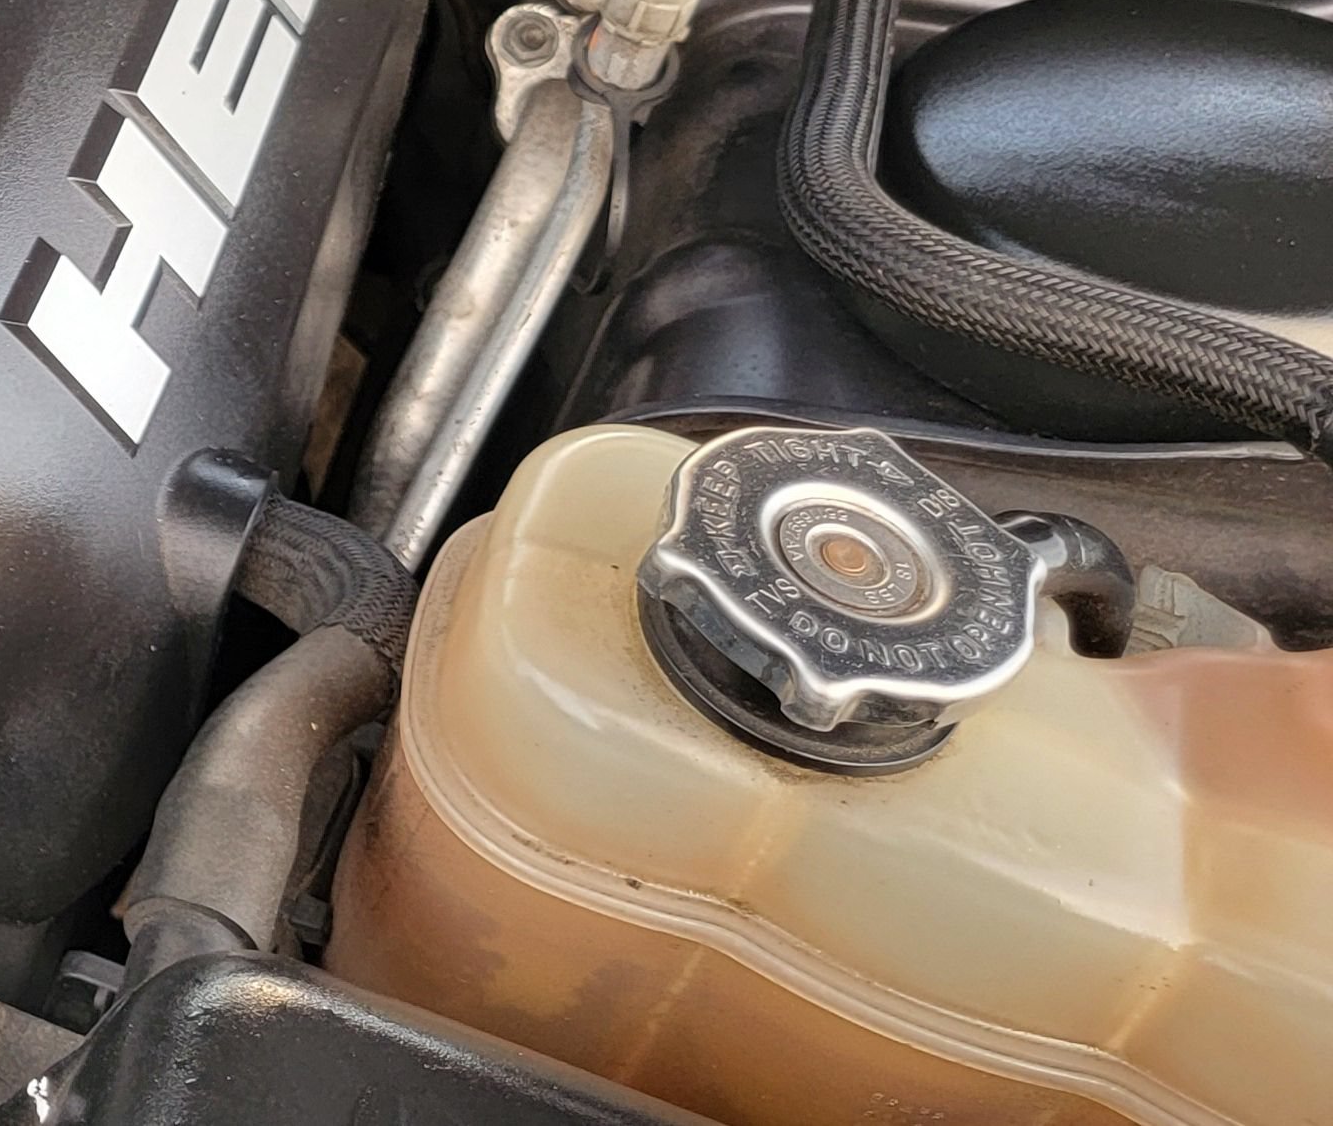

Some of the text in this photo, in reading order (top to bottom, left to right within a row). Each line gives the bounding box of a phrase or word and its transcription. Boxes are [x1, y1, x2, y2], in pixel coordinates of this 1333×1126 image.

[697, 438, 868, 539] KEEP TIGHT
[917, 488, 960, 518] D18
[895, 562, 912, 580] 18
[745, 577, 801, 616] TVS
[789, 521, 1015, 673] DO NOT OPEN HOT
